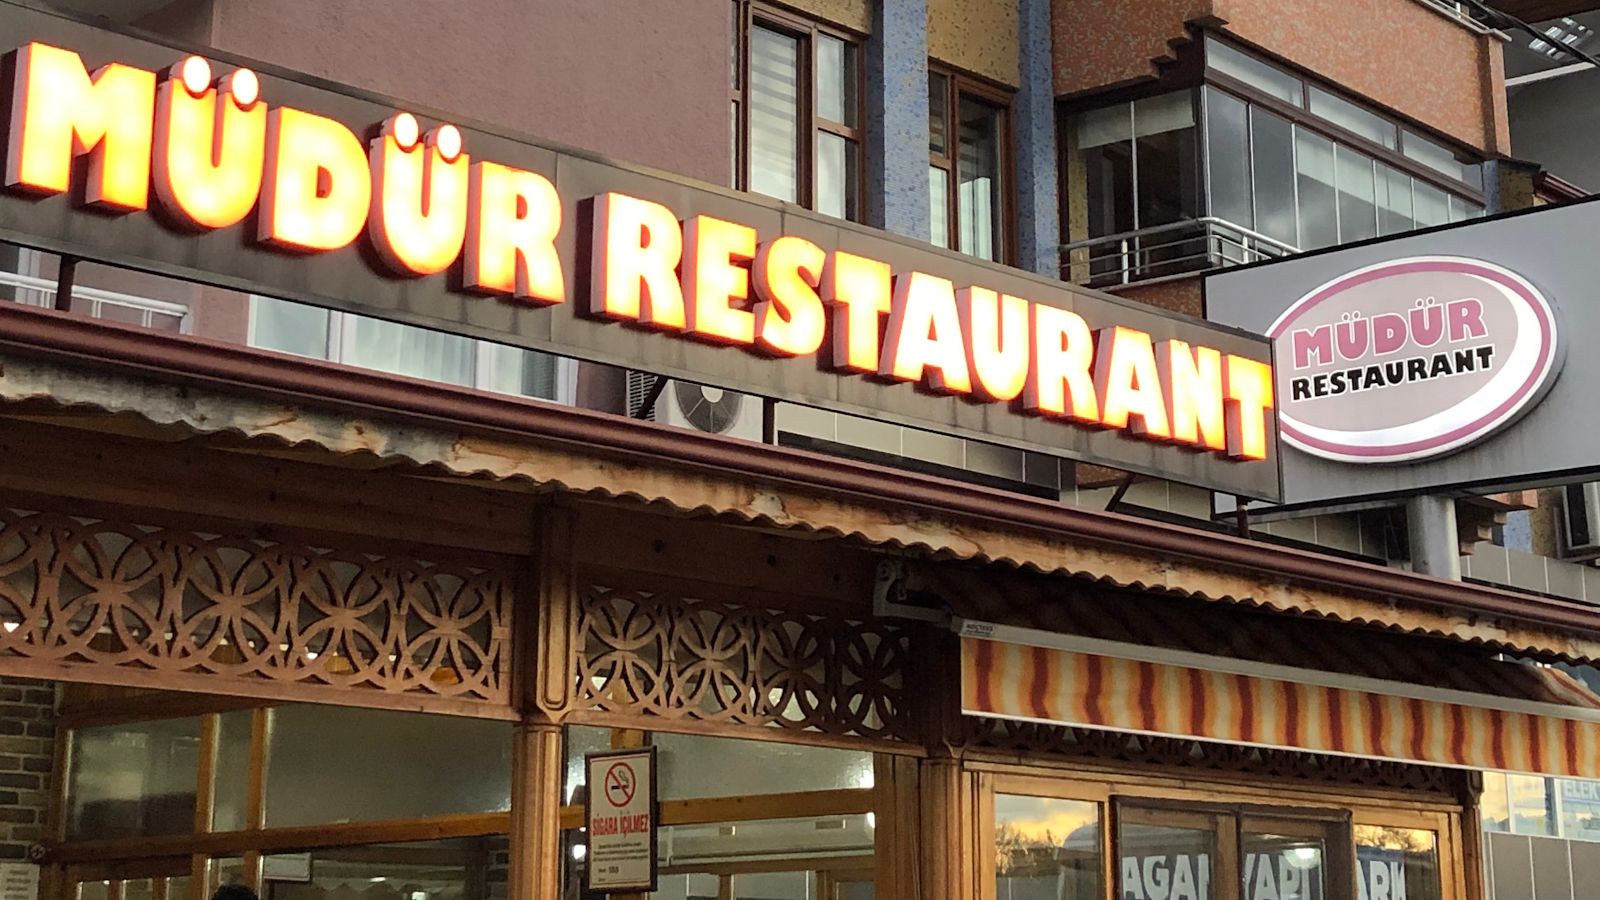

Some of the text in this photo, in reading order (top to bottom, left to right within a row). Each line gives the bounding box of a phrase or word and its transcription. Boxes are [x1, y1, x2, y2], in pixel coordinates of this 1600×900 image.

[8, 42, 1273, 461] MÜDÜR RESTAURANT
[1291, 296, 1489, 370] MÜDÜR
[1291, 344, 1496, 403] RESTAURANT
[593, 810, 649, 839] SİGARA İÇİLMEZ
